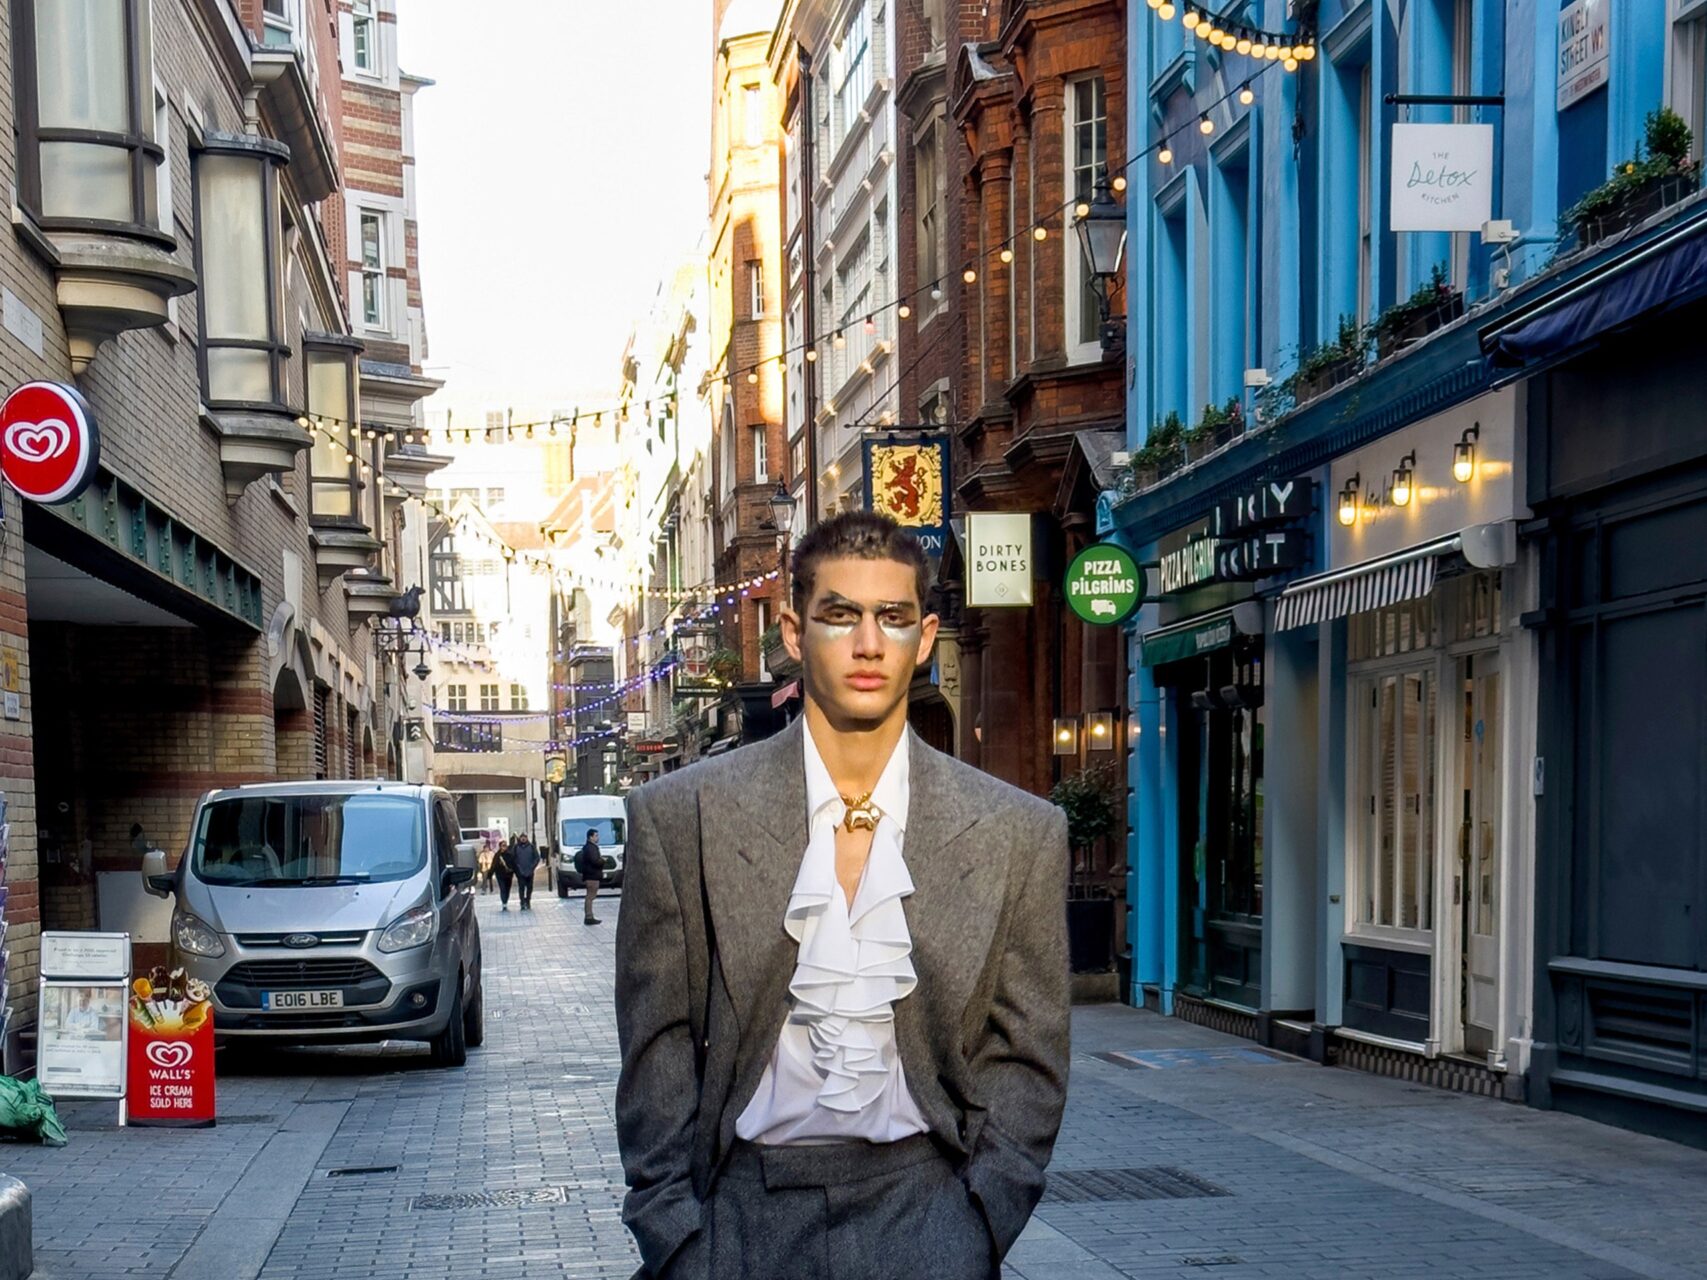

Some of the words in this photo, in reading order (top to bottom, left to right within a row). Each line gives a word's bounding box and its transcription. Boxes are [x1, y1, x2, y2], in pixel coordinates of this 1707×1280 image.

[1561, 33, 1589, 76] STREET
[1591, 23, 1604, 55] W1
[1432, 151, 1449, 160] THE
[1406, 160, 1477, 188] Detox
[1421, 192, 1460, 205] KITCHEN
[979, 544, 1023, 557] DIRTY
[976, 559, 1027, 572] BONES
[1084, 560, 1122, 575] PIZZA
[1161, 550, 1182, 594] PIZZA
[310, 991, 338, 1006] LBE
[149, 1069, 191, 1080] WALL'S
[150, 1085, 162, 1096] ICE
[164, 1085, 193, 1096] CREAM
[150, 1097, 171, 1109] SOLD
[173, 1097, 193, 1109] HERE
